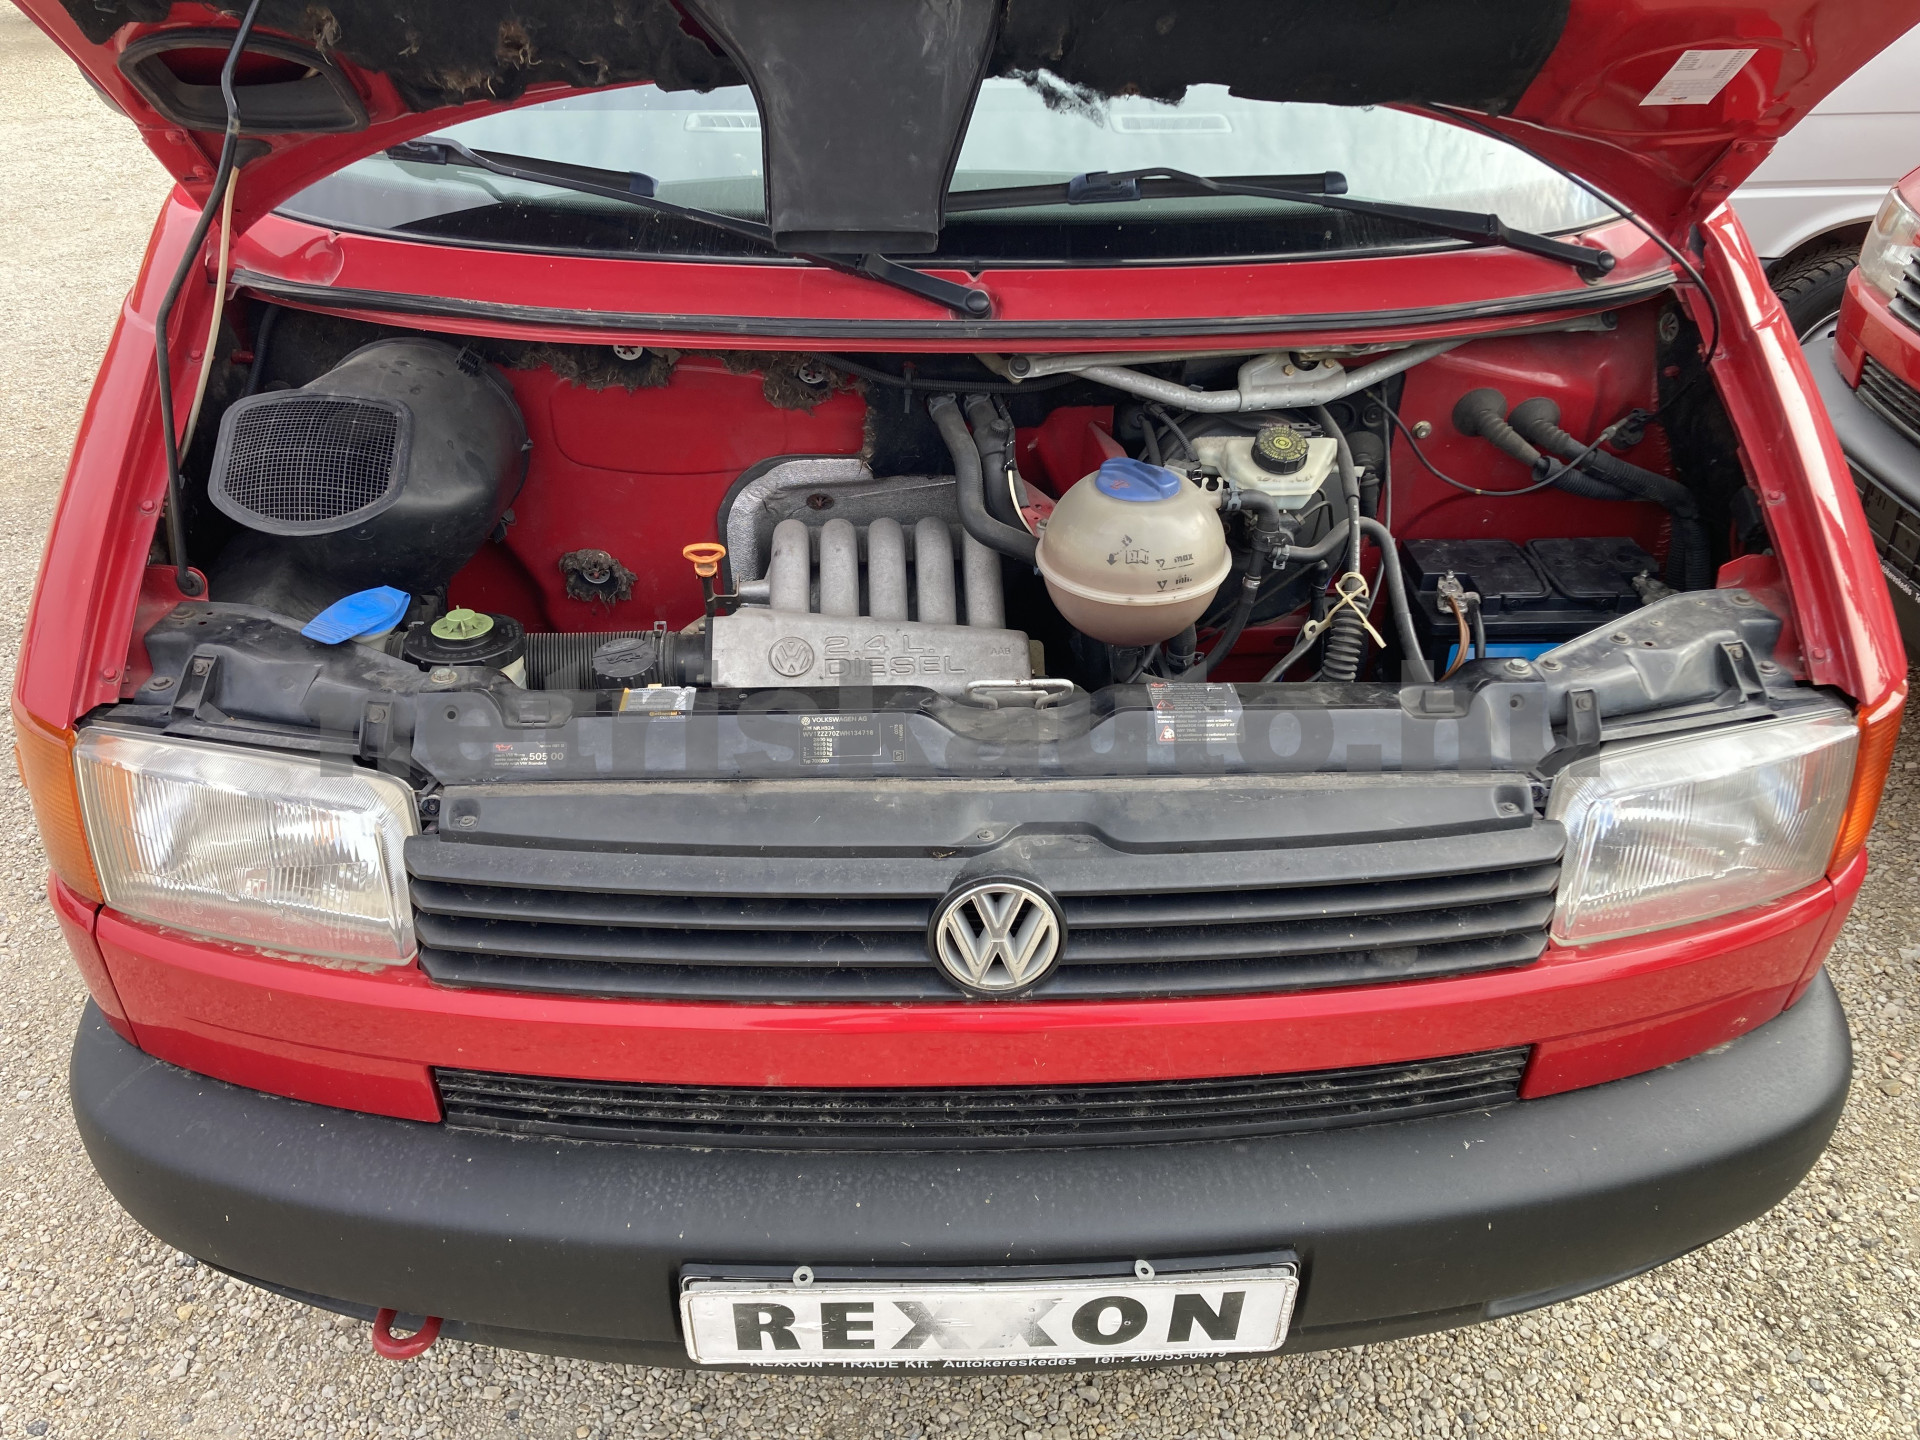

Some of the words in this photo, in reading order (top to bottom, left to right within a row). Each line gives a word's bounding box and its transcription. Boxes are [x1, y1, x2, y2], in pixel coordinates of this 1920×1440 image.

[824, 634, 889, 655] 2.4
[824, 655, 967, 679] DIESEL
[811, 715, 857, 723] VOLKSWAGEN
[529, 752, 549, 761] 505
[550, 752, 564, 761] 00
[842, 1360, 899, 1369] TRADE
